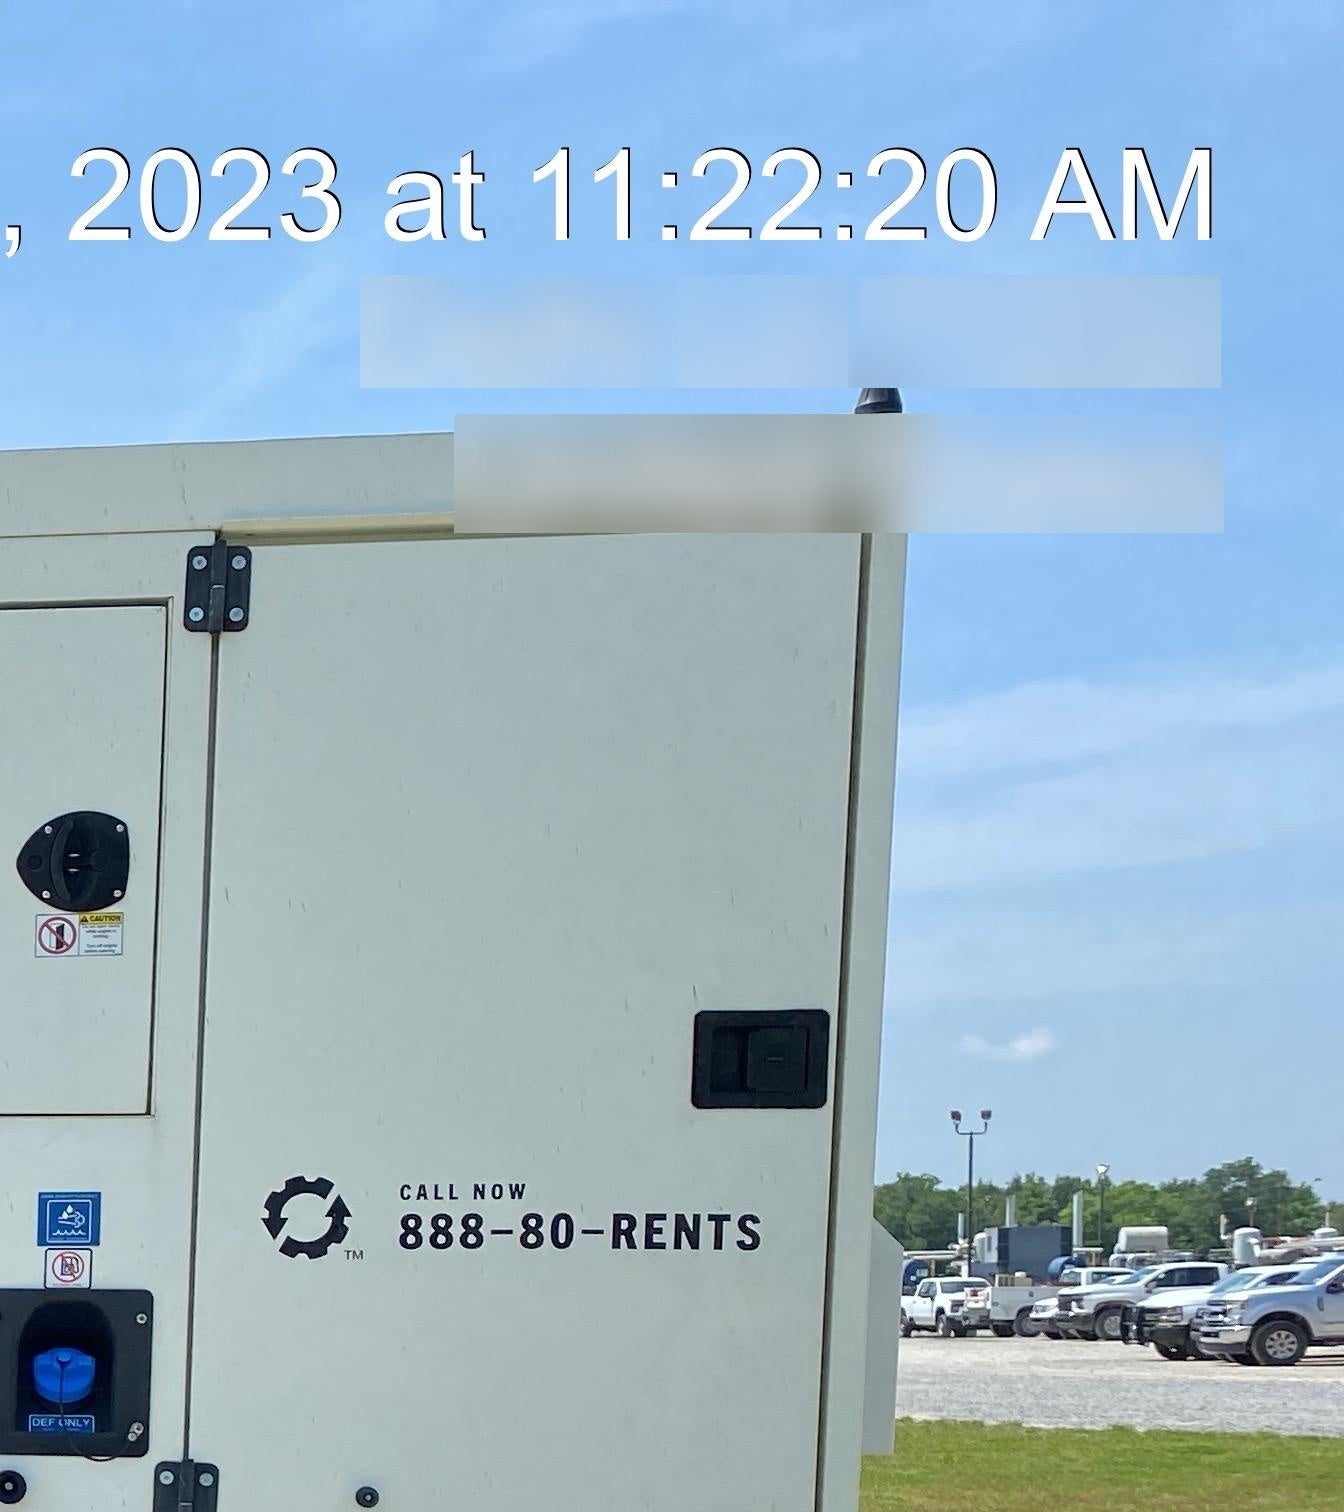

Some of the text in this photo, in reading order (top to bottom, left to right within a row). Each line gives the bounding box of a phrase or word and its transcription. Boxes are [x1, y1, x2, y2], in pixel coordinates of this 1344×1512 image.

[399, 1183, 526, 1201] CALL NOW
[398, 1212, 762, 1251] 888-80-RENTS
[32, 1417, 56, 1427] DEF
